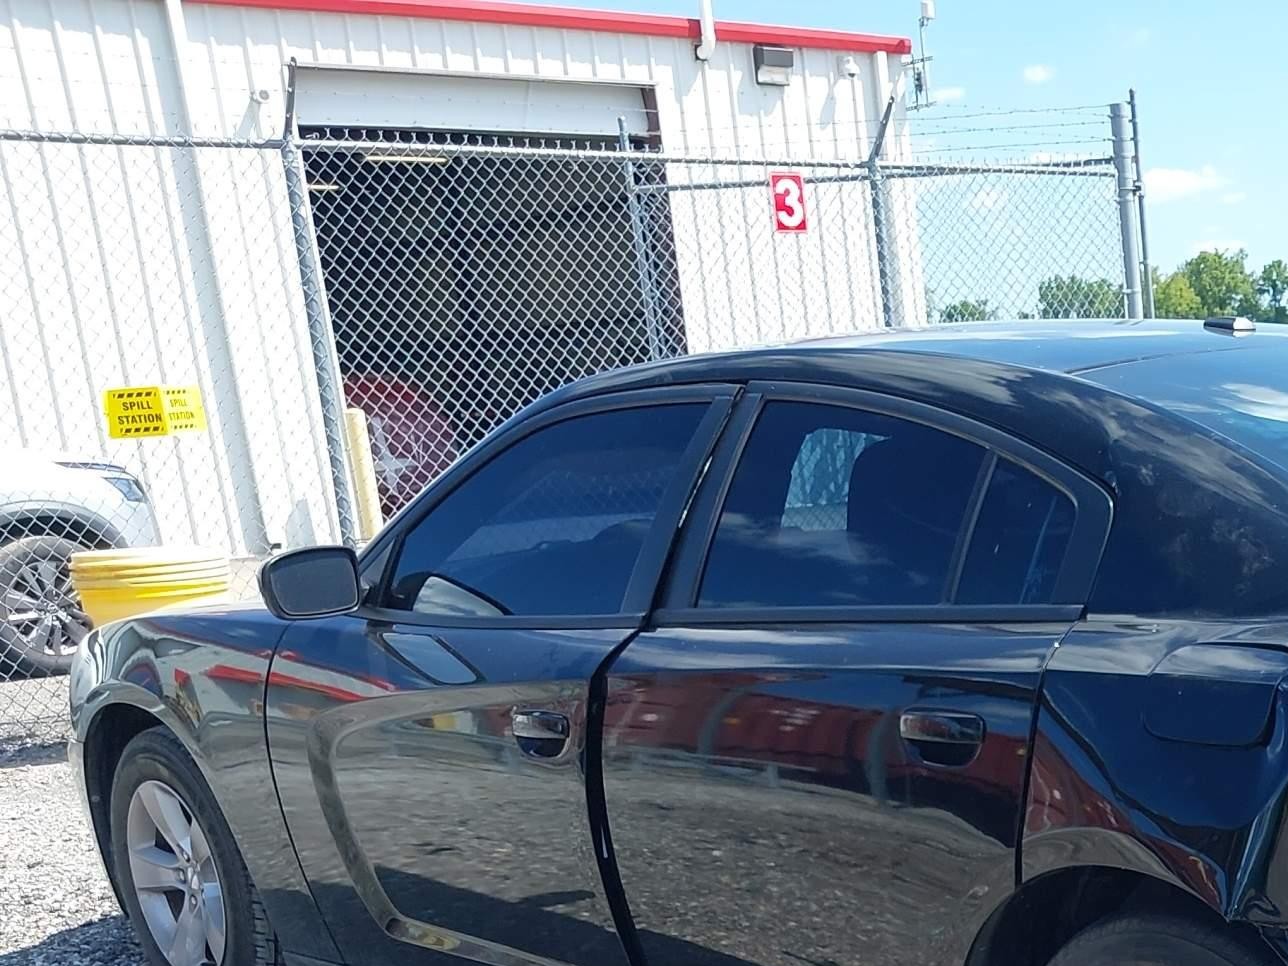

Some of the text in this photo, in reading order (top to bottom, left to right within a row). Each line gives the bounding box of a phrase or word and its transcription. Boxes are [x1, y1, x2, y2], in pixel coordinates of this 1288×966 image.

[775, 177, 804, 227] 3
[122, 400, 153, 411] SPILL
[169, 399, 188, 408] SPILL
[117, 413, 162, 425] STATION
[168, 411, 195, 421] STATION
